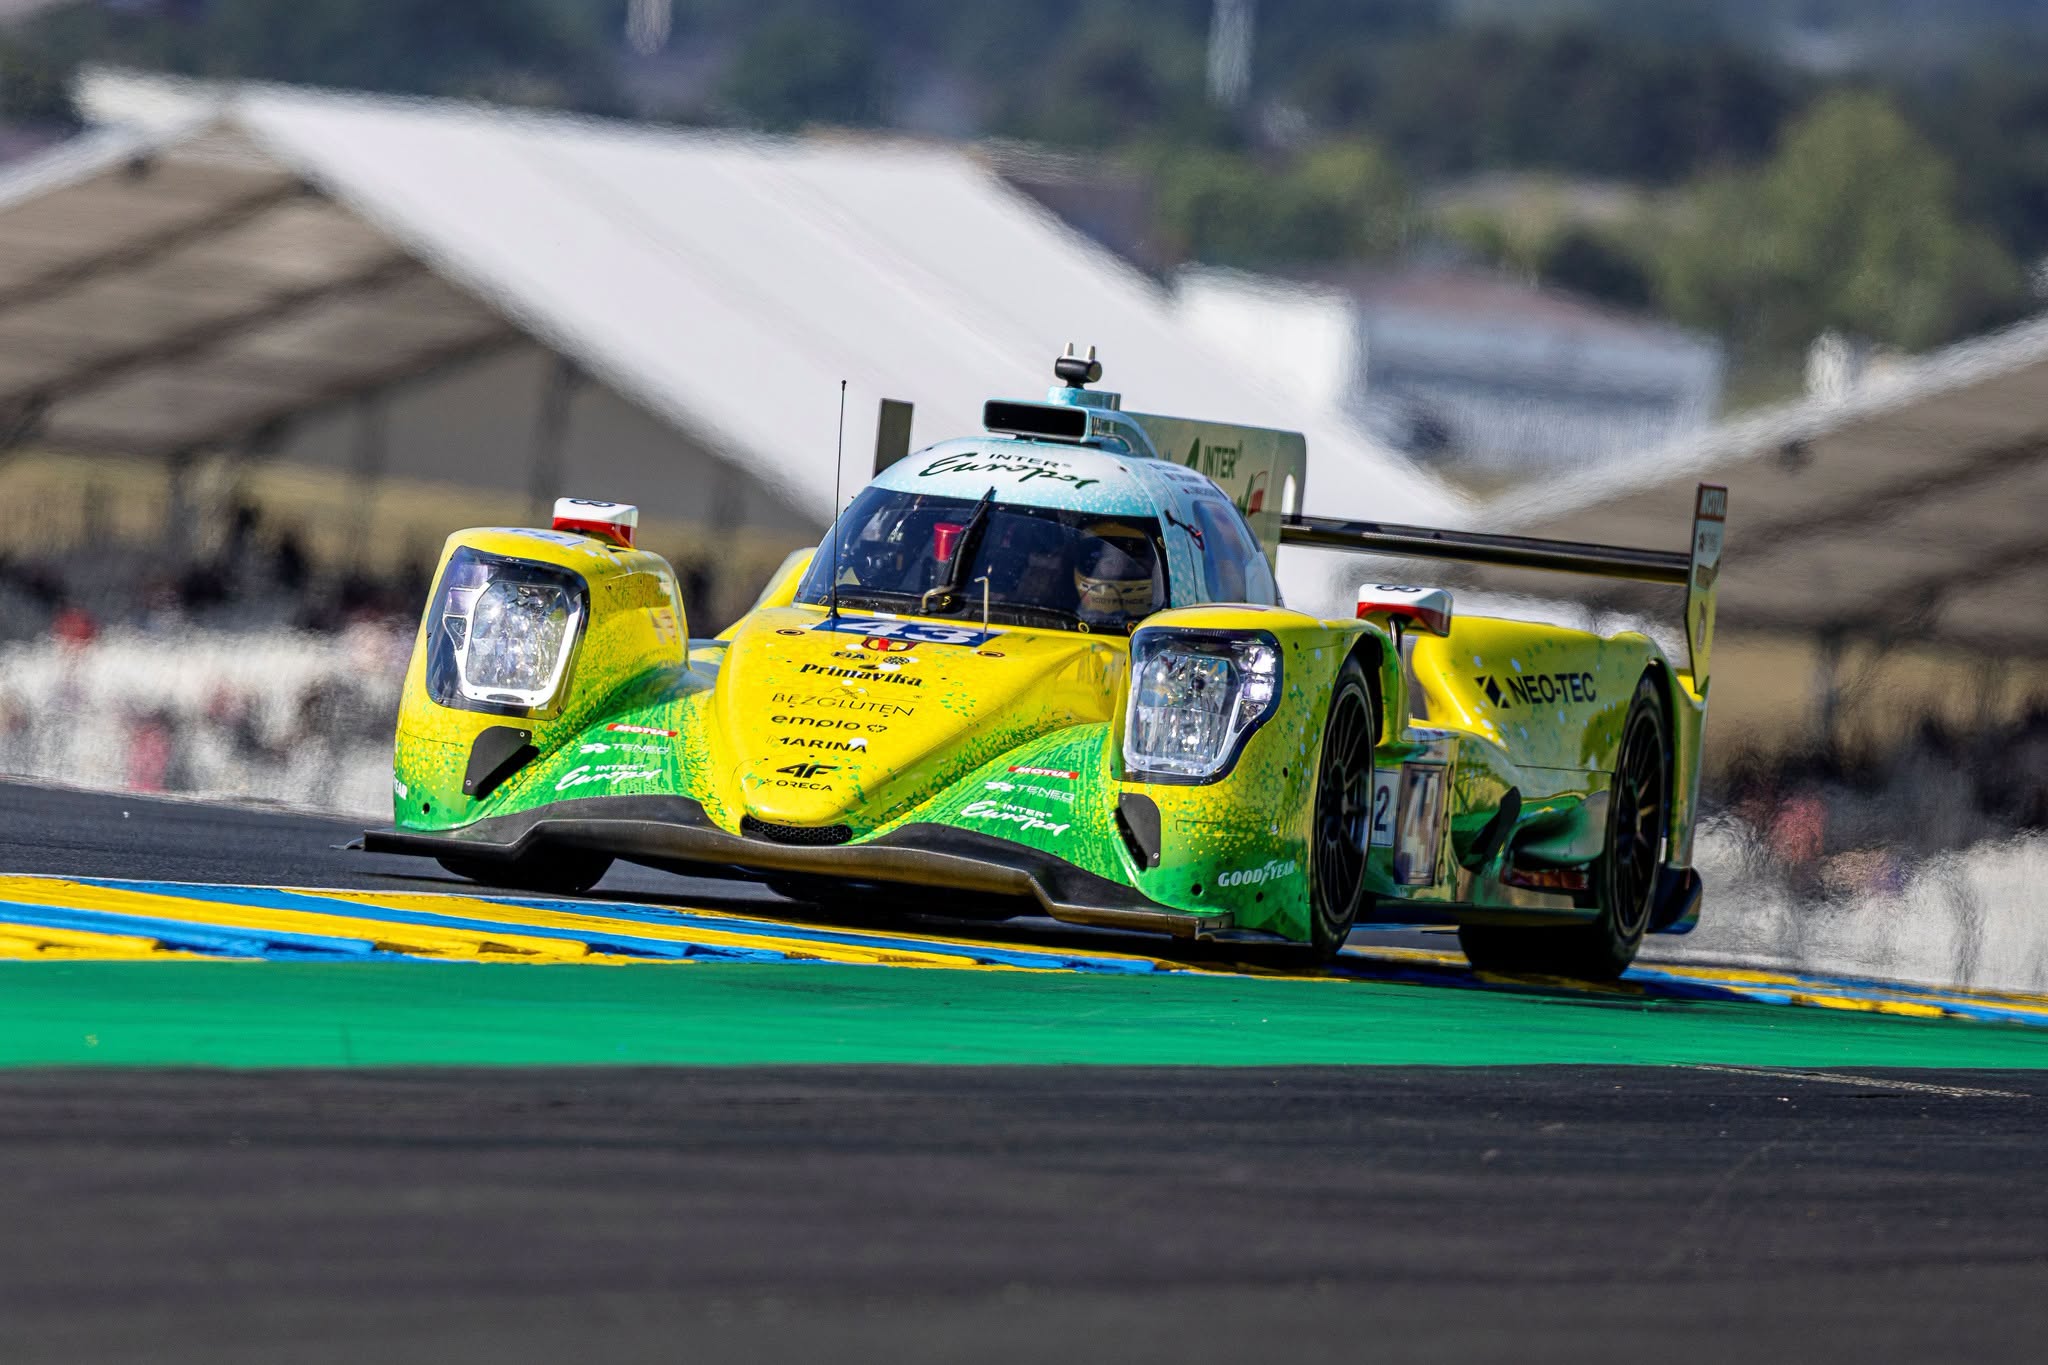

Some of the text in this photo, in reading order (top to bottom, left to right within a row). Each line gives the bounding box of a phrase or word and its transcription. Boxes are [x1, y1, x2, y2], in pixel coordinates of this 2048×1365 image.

[989, 453, 1059, 468] INTER
[836, 620, 978, 643] 43
[832, 650, 867, 661] FIA
[800, 663, 923, 687] Primavika
[1505, 672, 1597, 705] NEO-TEC
[772, 692, 915, 717] BEZGLUTEN
[771, 714, 861, 731] emplo
[1014, 766, 1071, 779] MOTUL
[776, 779, 833, 791] ORECA
[1002, 803, 1047, 819] INTER
[1374, 785, 1391, 832] 2
[1217, 859, 1297, 888] GOODYEAR
